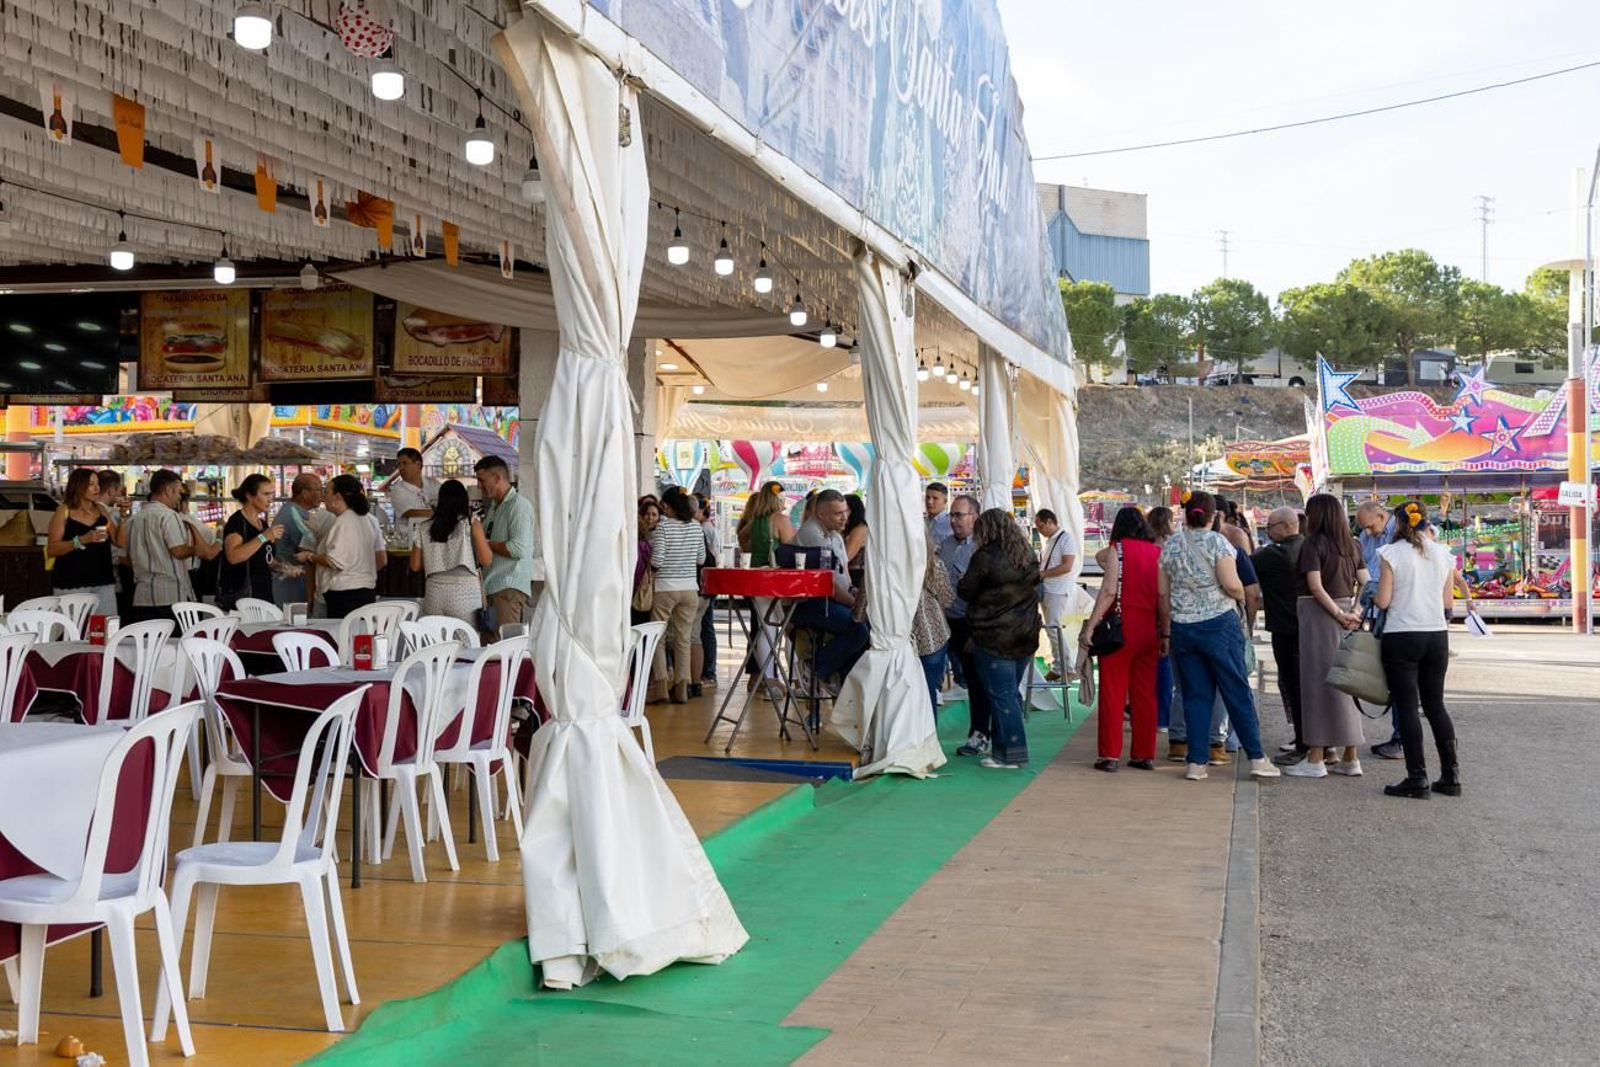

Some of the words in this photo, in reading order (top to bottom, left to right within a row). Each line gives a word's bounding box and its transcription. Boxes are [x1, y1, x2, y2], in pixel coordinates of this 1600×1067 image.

[408, 355, 450, 366] BOCADILLO
[451, 356, 461, 366] DE
[316, 363, 347, 373] SANTA
[196, 374, 225, 383] SANTA
[226, 374, 246, 383] ANA
[425, 389, 451, 397] SANTA
[452, 389, 470, 397] ANA
